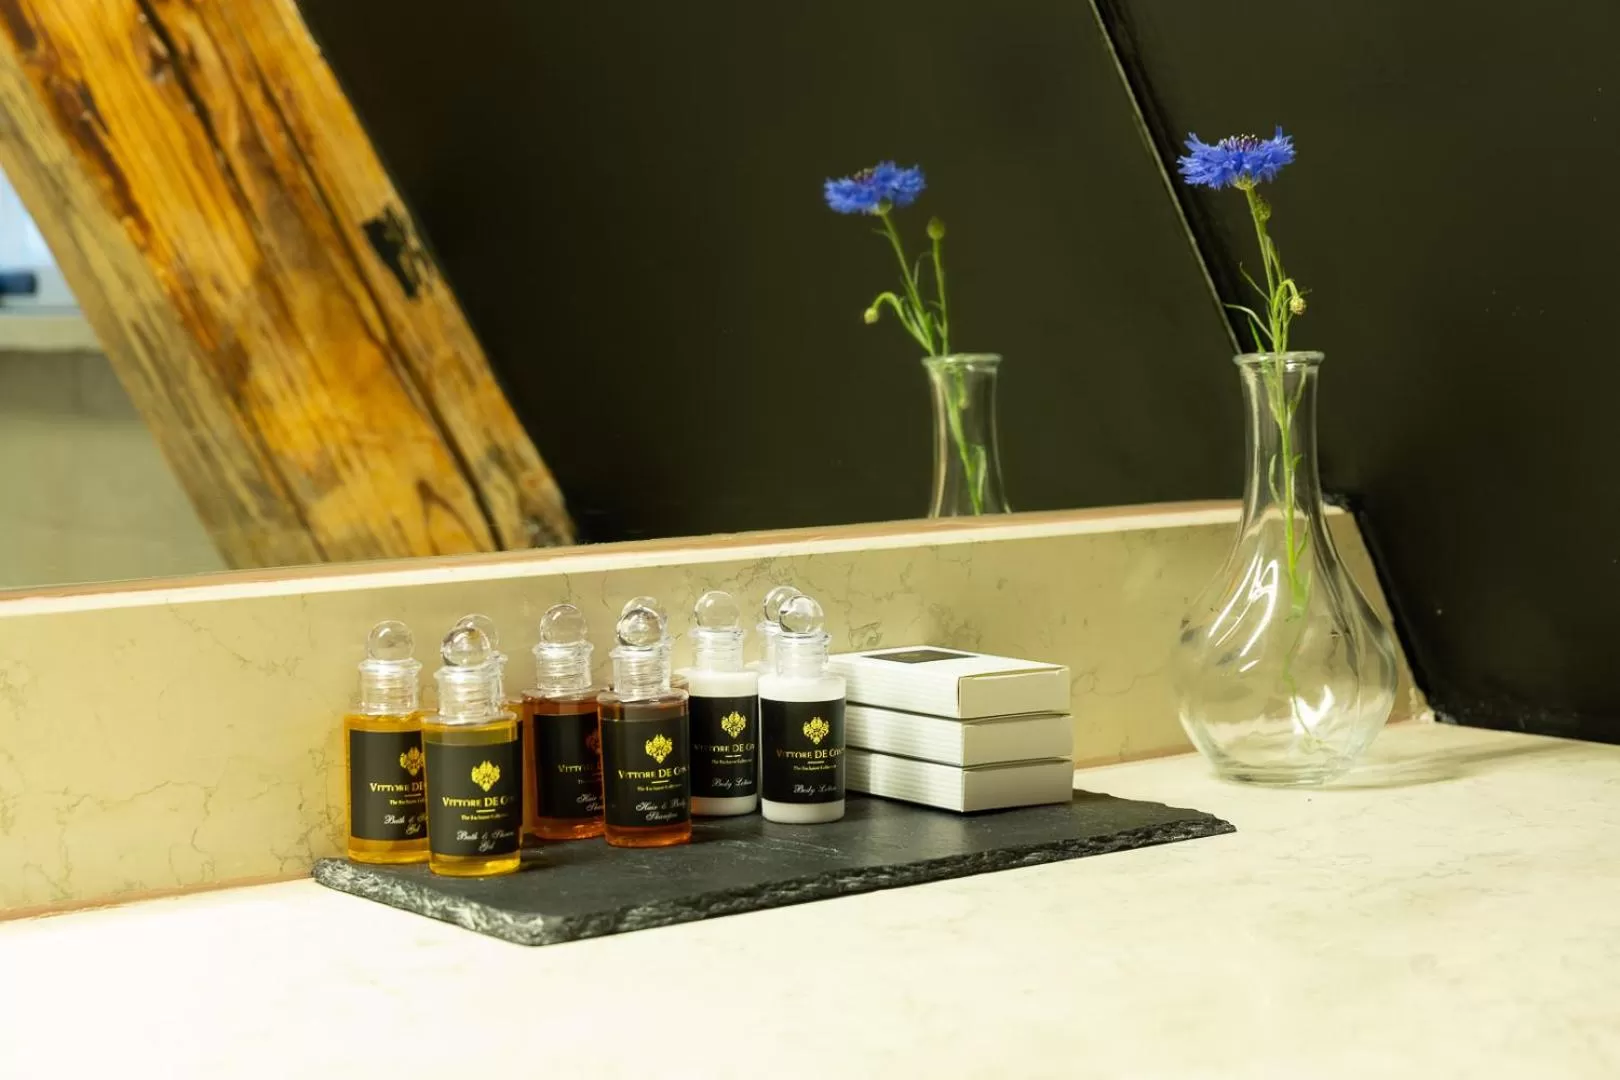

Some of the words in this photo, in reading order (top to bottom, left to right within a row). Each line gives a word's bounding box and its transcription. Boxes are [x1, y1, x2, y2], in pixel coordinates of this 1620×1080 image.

[814, 749, 828, 759] DE
[658, 768, 672, 778] DE
[483, 796, 499, 807] DE
